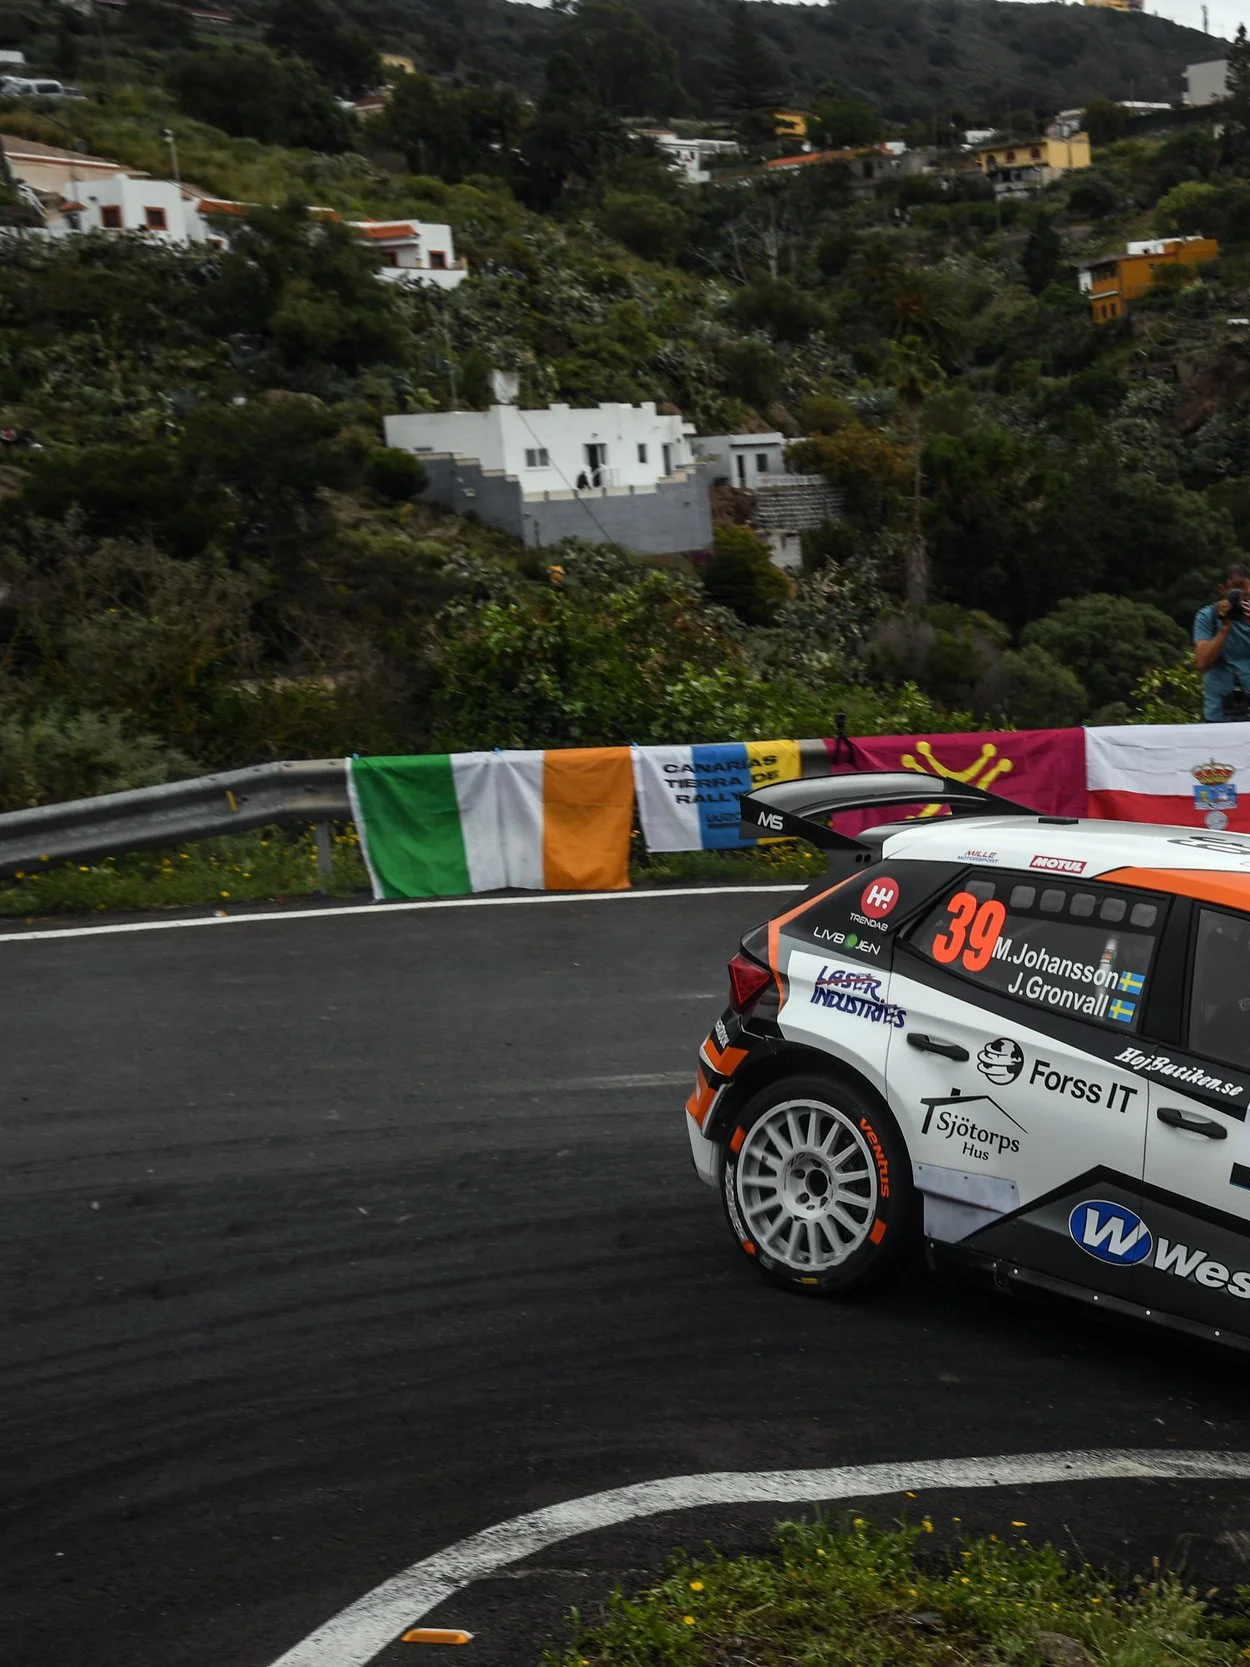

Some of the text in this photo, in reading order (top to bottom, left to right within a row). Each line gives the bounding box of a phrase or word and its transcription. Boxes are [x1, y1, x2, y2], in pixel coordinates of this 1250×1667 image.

[662, 755, 778, 774] CANARIAS
[663, 770, 781, 789] TIERRA DE
[757, 810, 784, 831] MS
[1031, 856, 1084, 873] MOTUL
[849, 912, 889, 932] TRENDAB
[931, 891, 1007, 973] 39
[991, 935, 1120, 990] M.Johansson
[809, 986, 908, 1029] INDUSTRIES
[1007, 972, 1111, 1018] J.Gronvall
[1028, 1059, 1139, 1114] Forss IT
[936, 1110, 1021, 1155] Sjötorps
[961, 1141, 990, 1162] Hus
[1081, 1206, 1147, 1257] W
